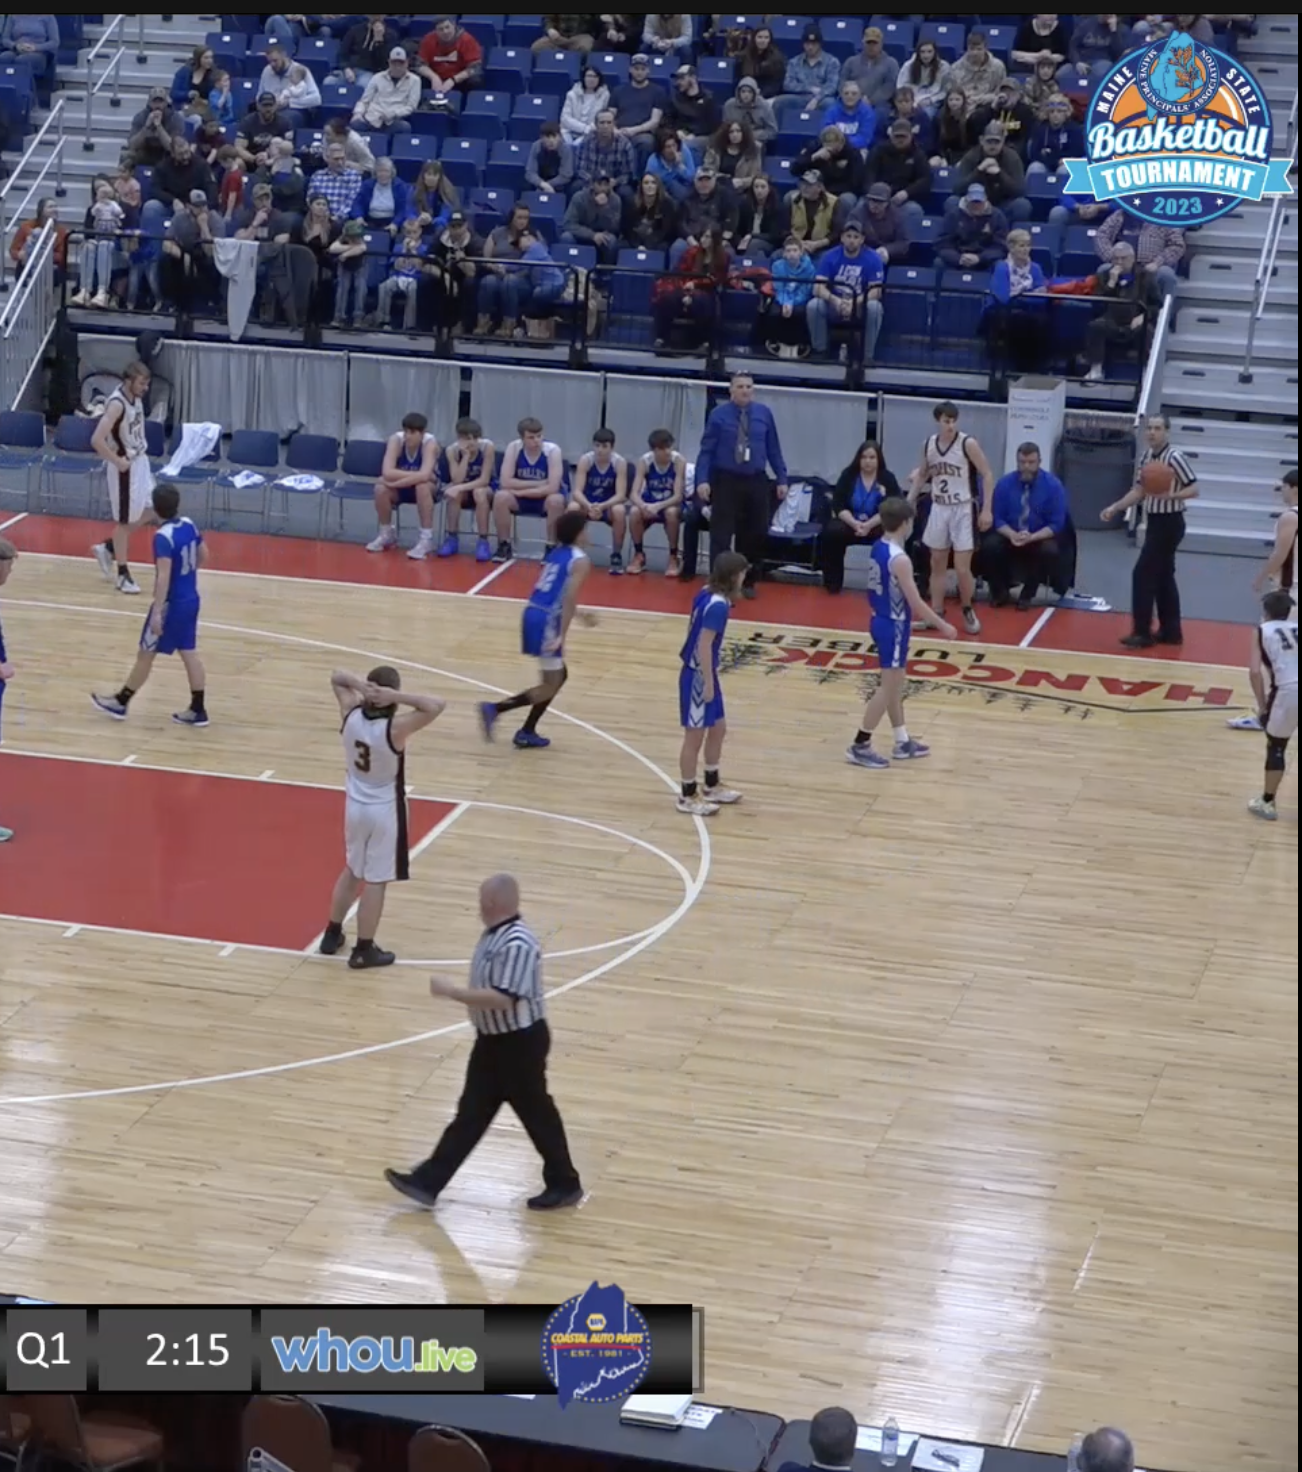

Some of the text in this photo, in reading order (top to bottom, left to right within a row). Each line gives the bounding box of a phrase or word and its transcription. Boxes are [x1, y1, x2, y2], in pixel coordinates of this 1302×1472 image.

[939, 479, 949, 494] 2
[749, 632, 985, 663] LUBER
[766, 646, 1233, 705] HANCOCK
[354, 739, 371, 773] 3
